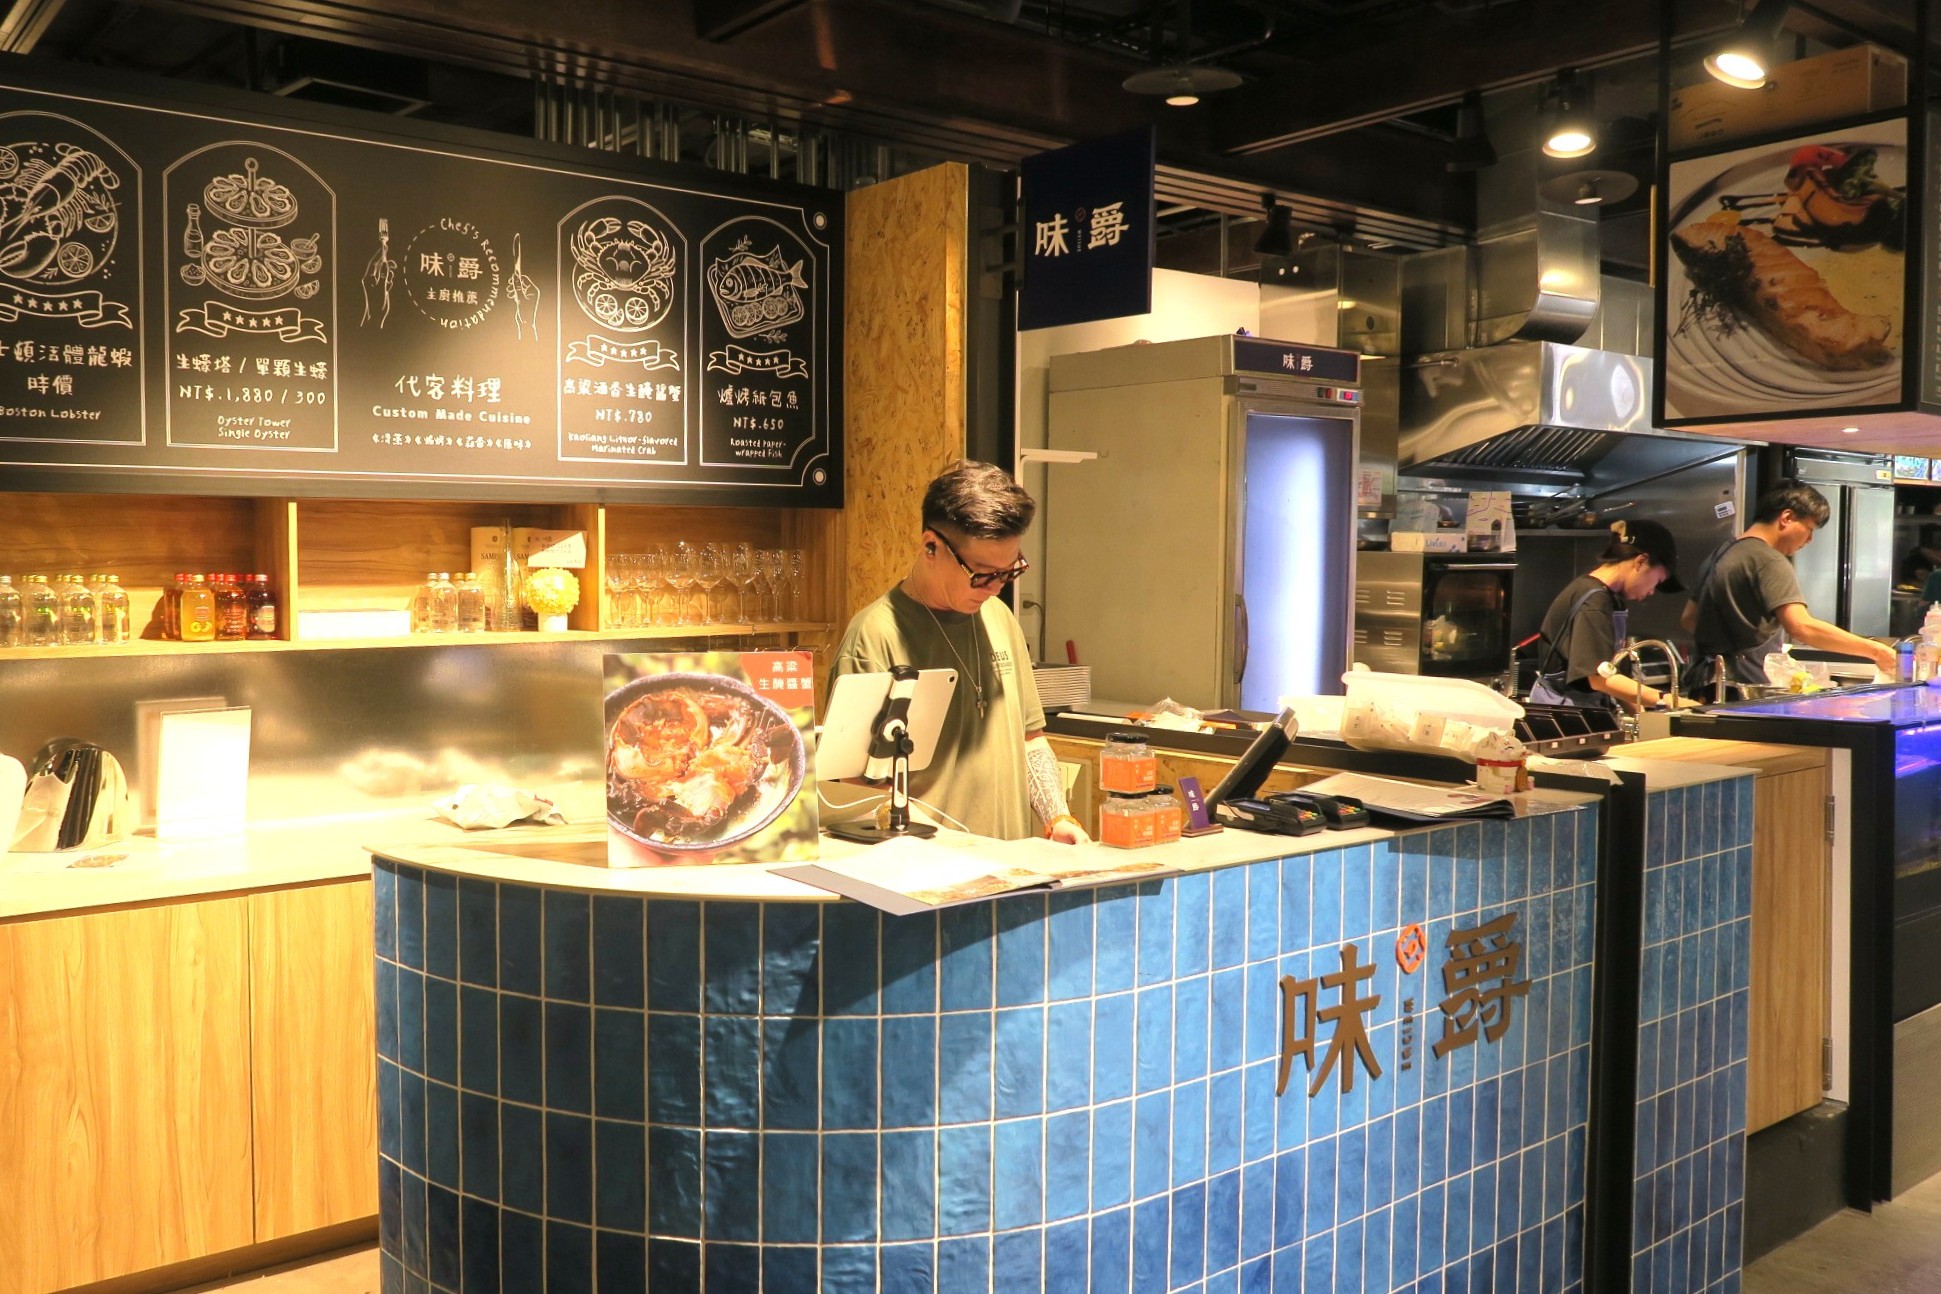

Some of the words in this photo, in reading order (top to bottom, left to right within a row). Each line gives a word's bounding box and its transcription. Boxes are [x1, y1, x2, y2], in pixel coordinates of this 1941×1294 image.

[1034, 201, 1130, 257] 味爵
[420, 252, 483, 280] 味爵
[440, 239, 500, 330] Recommendation
[427, 287, 478, 305] 主廚推薦
[176, 353, 232, 374] 生蠔塔
[255, 357, 329, 380] 單顆生蠔
[1282, 353, 1314, 372] 味爵
[27, 373, 73, 396] 時價
[394, 373, 502, 403] 代客料理
[295, 391, 326, 405] 300
[0, 405, 46, 418] Boston
[51, 408, 102, 420] Lobster
[217, 415, 255, 427] Oyster
[258, 417, 292, 428] Tower
[372, 405, 429, 420] Custom
[435, 408, 473, 423] Made
[478, 410, 532, 425] Cuisine
[733, 416, 784, 431] NT$.650
[218, 428, 250, 440] Single
[254, 429, 291, 440] Oyster
[1275, 911, 1533, 1099] 味爵
